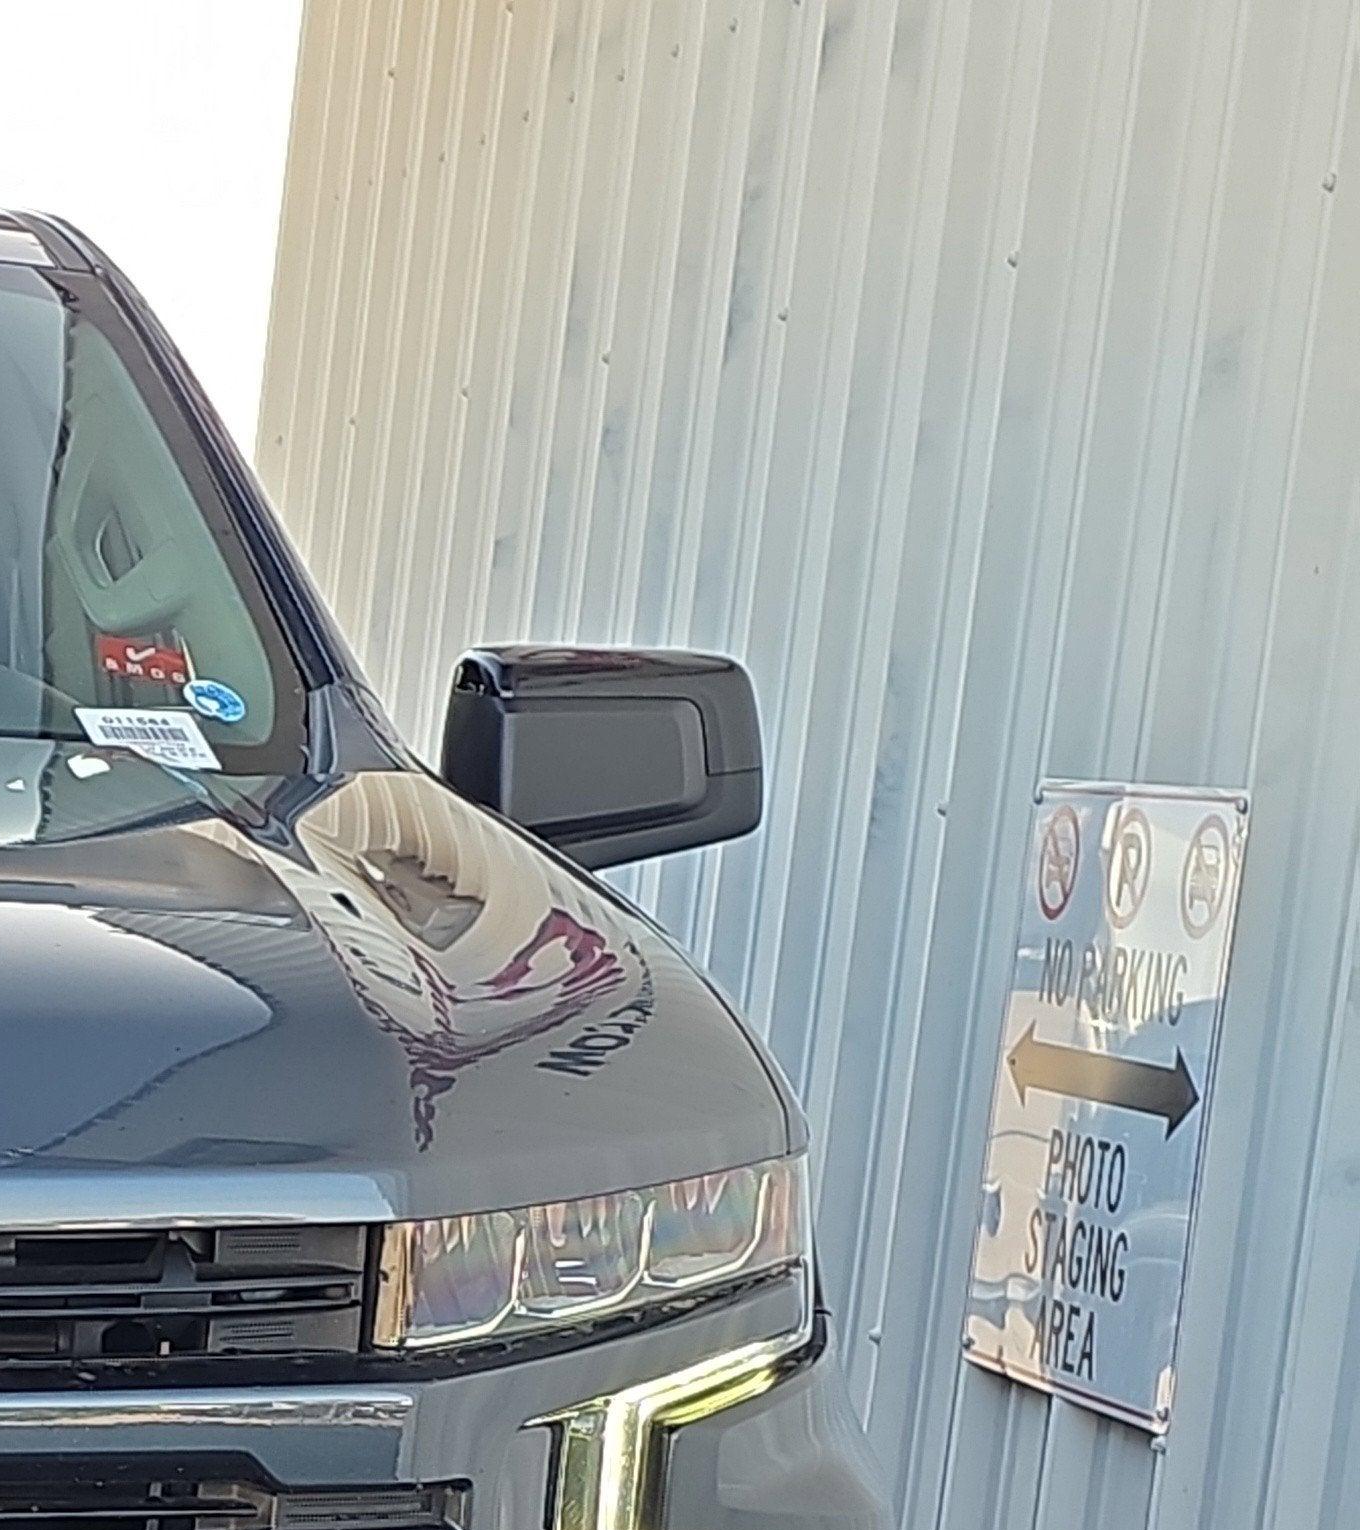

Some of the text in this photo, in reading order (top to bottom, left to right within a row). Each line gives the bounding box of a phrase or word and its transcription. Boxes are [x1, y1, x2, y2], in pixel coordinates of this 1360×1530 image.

[1039, 936, 1188, 1027] NO PARKING
[1044, 1128, 1126, 1214] PHOTO
[1024, 1207, 1129, 1303] STAGING
[1029, 1295, 1096, 1382] AREA
